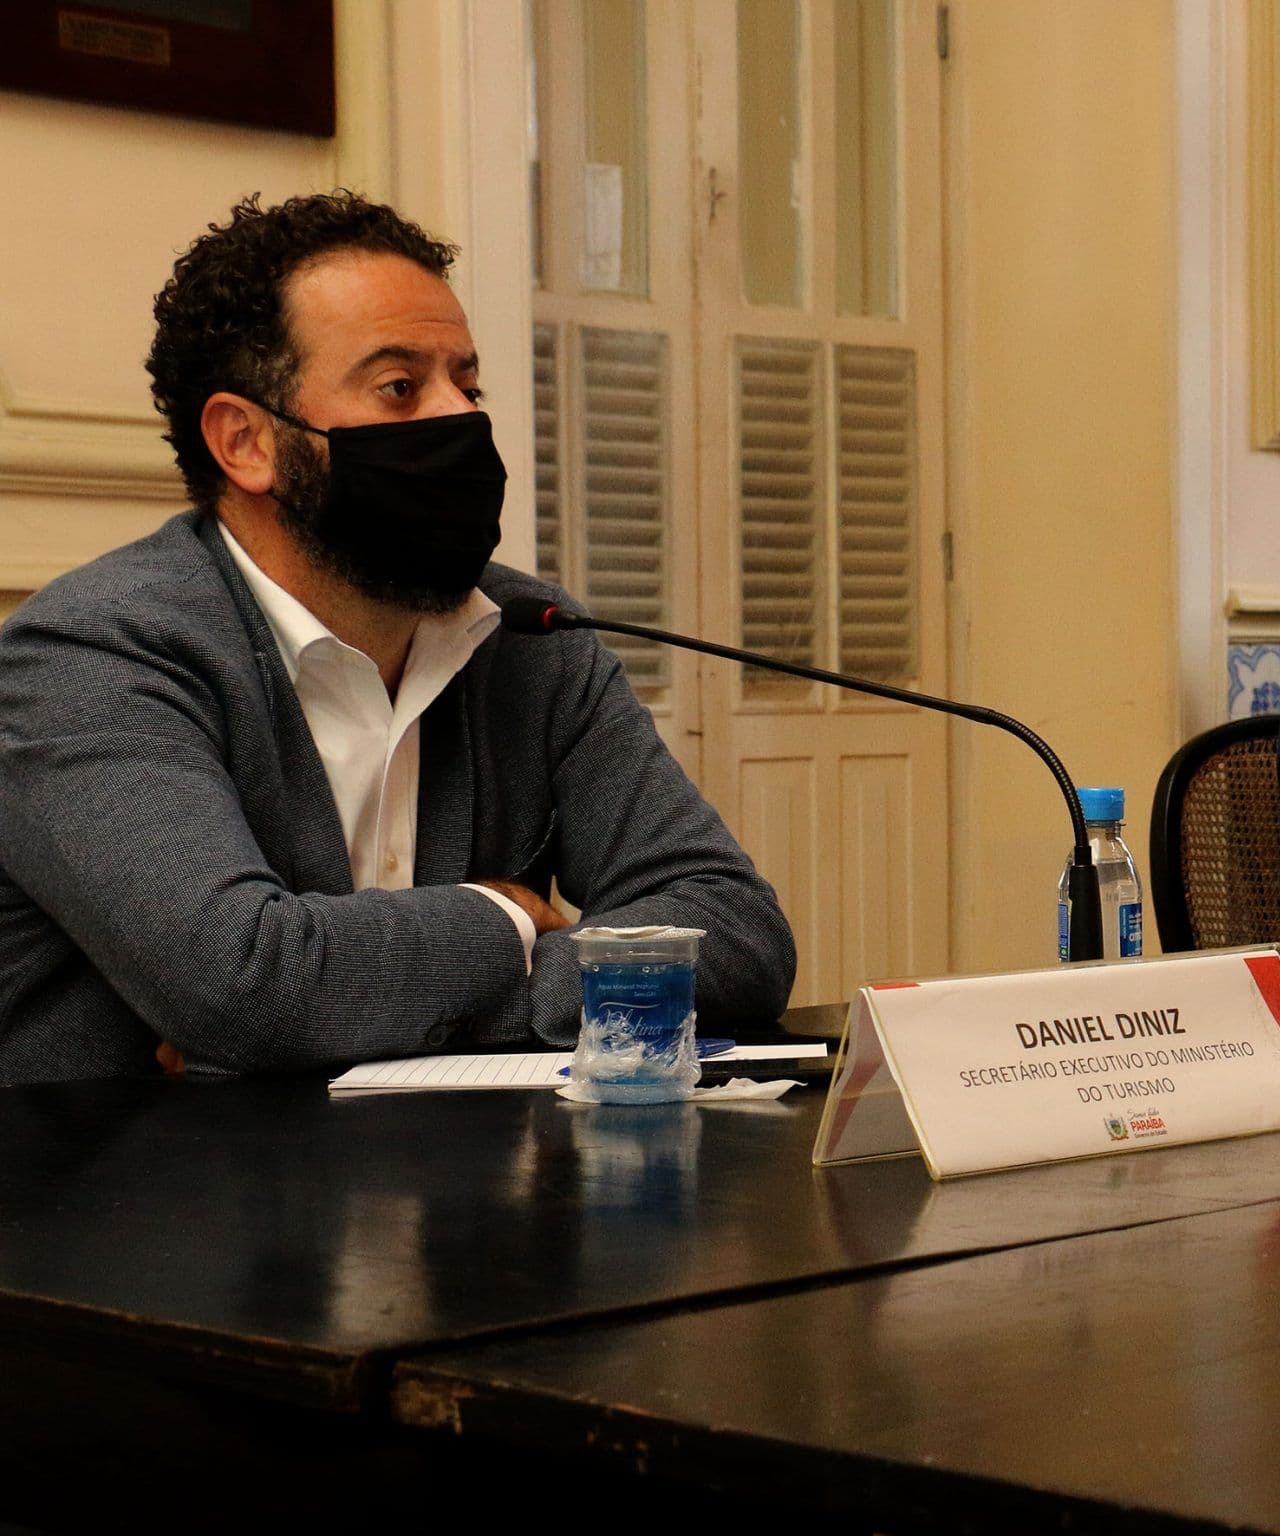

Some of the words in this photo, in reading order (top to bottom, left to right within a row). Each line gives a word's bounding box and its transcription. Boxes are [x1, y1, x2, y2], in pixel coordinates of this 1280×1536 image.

[1016, 1016, 1114, 1049] DANIEL
[1116, 1008, 1186, 1037] DINIZ
[959, 1060, 1058, 1088] SECRETÁRIO
[1060, 1053, 1144, 1076] EXECUTIVO
[1146, 1050, 1170, 1066] DO
[1171, 1040, 1255, 1064] MINISTÉRIO
[1077, 1086, 1102, 1103] DO
[1103, 1077, 1175, 1099] TURISMO
[1130, 1116, 1166, 1132] PARAÍBA
